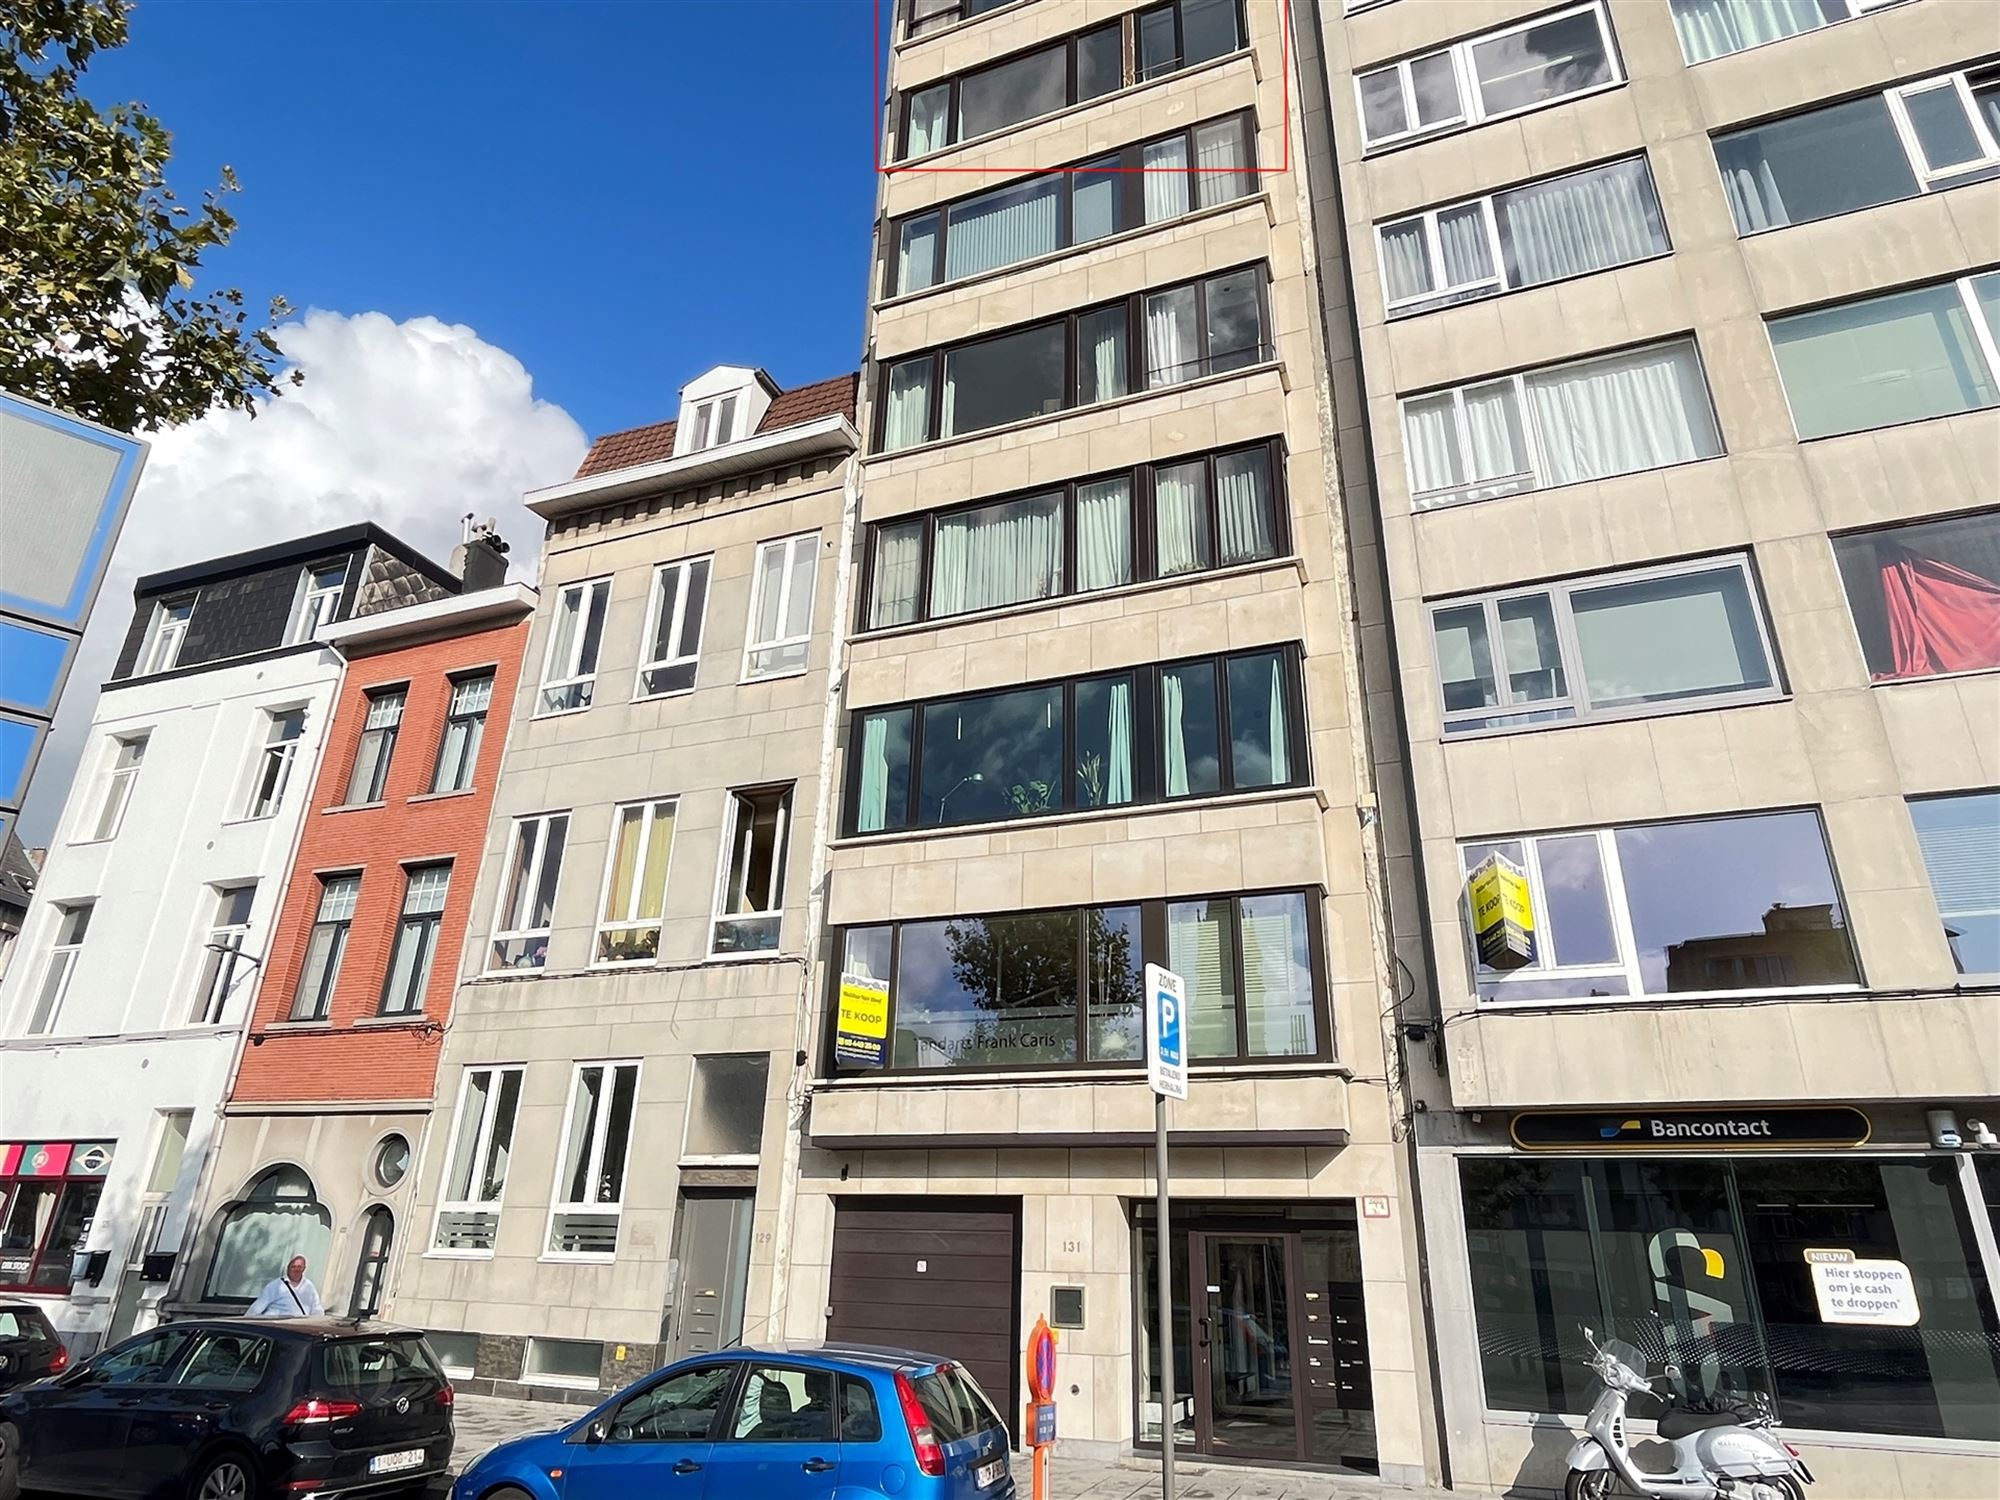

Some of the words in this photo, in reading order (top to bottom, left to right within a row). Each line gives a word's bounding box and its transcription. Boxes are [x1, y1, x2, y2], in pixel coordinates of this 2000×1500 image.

[1158, 973, 1177, 993] ZONE
[841, 1009, 852, 1020] TE
[854, 1012, 882, 1024] KOOP
[1162, 997, 1175, 1038] P
[977, 1033, 1016, 1049] Frank
[1020, 1032, 1056, 1048] Caris
[1651, 1119, 1772, 1137] Bancontact
[755, 1232, 771, 1244] 129
[1063, 1241, 1080, 1253] 131
[1811, 1251, 1849, 1262] NIEUW
[1825, 1267, 1850, 1278] Hier
[1853, 1269, 1902, 1281] stoppen
[1828, 1284, 1848, 1293] om
[1850, 1282, 1862, 1295] je
[1864, 1284, 1892, 1294] cash
[1831, 1297, 1844, 1307] te
